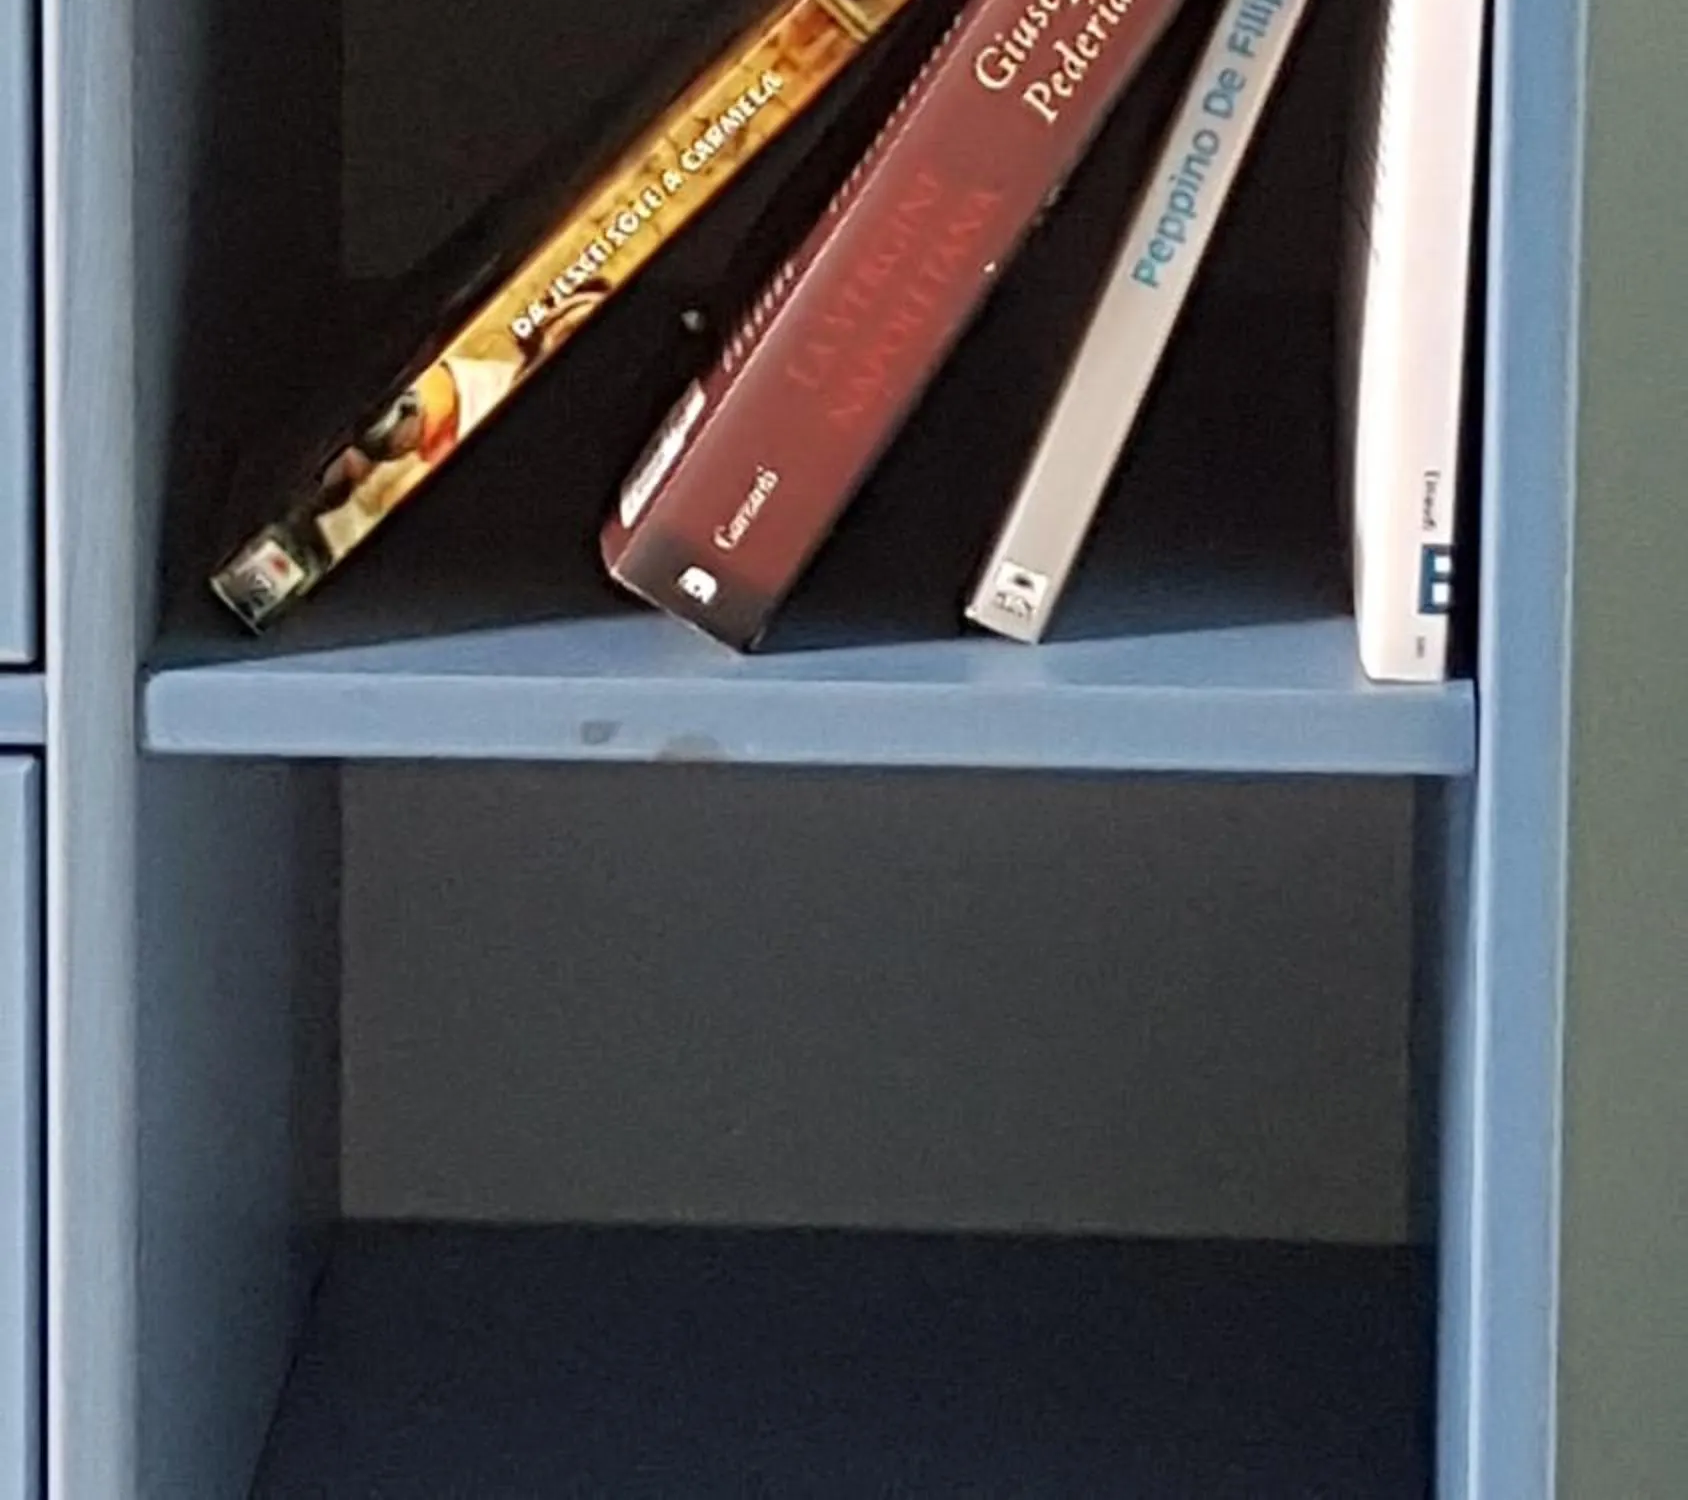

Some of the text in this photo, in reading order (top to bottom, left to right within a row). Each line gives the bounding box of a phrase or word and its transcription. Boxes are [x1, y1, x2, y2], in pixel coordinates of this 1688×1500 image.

[662, 168, 685, 192] A
[680, 69, 785, 173] CARMELA
[1131, 128, 1220, 288] Peppino
[1202, 67, 1247, 120] De
